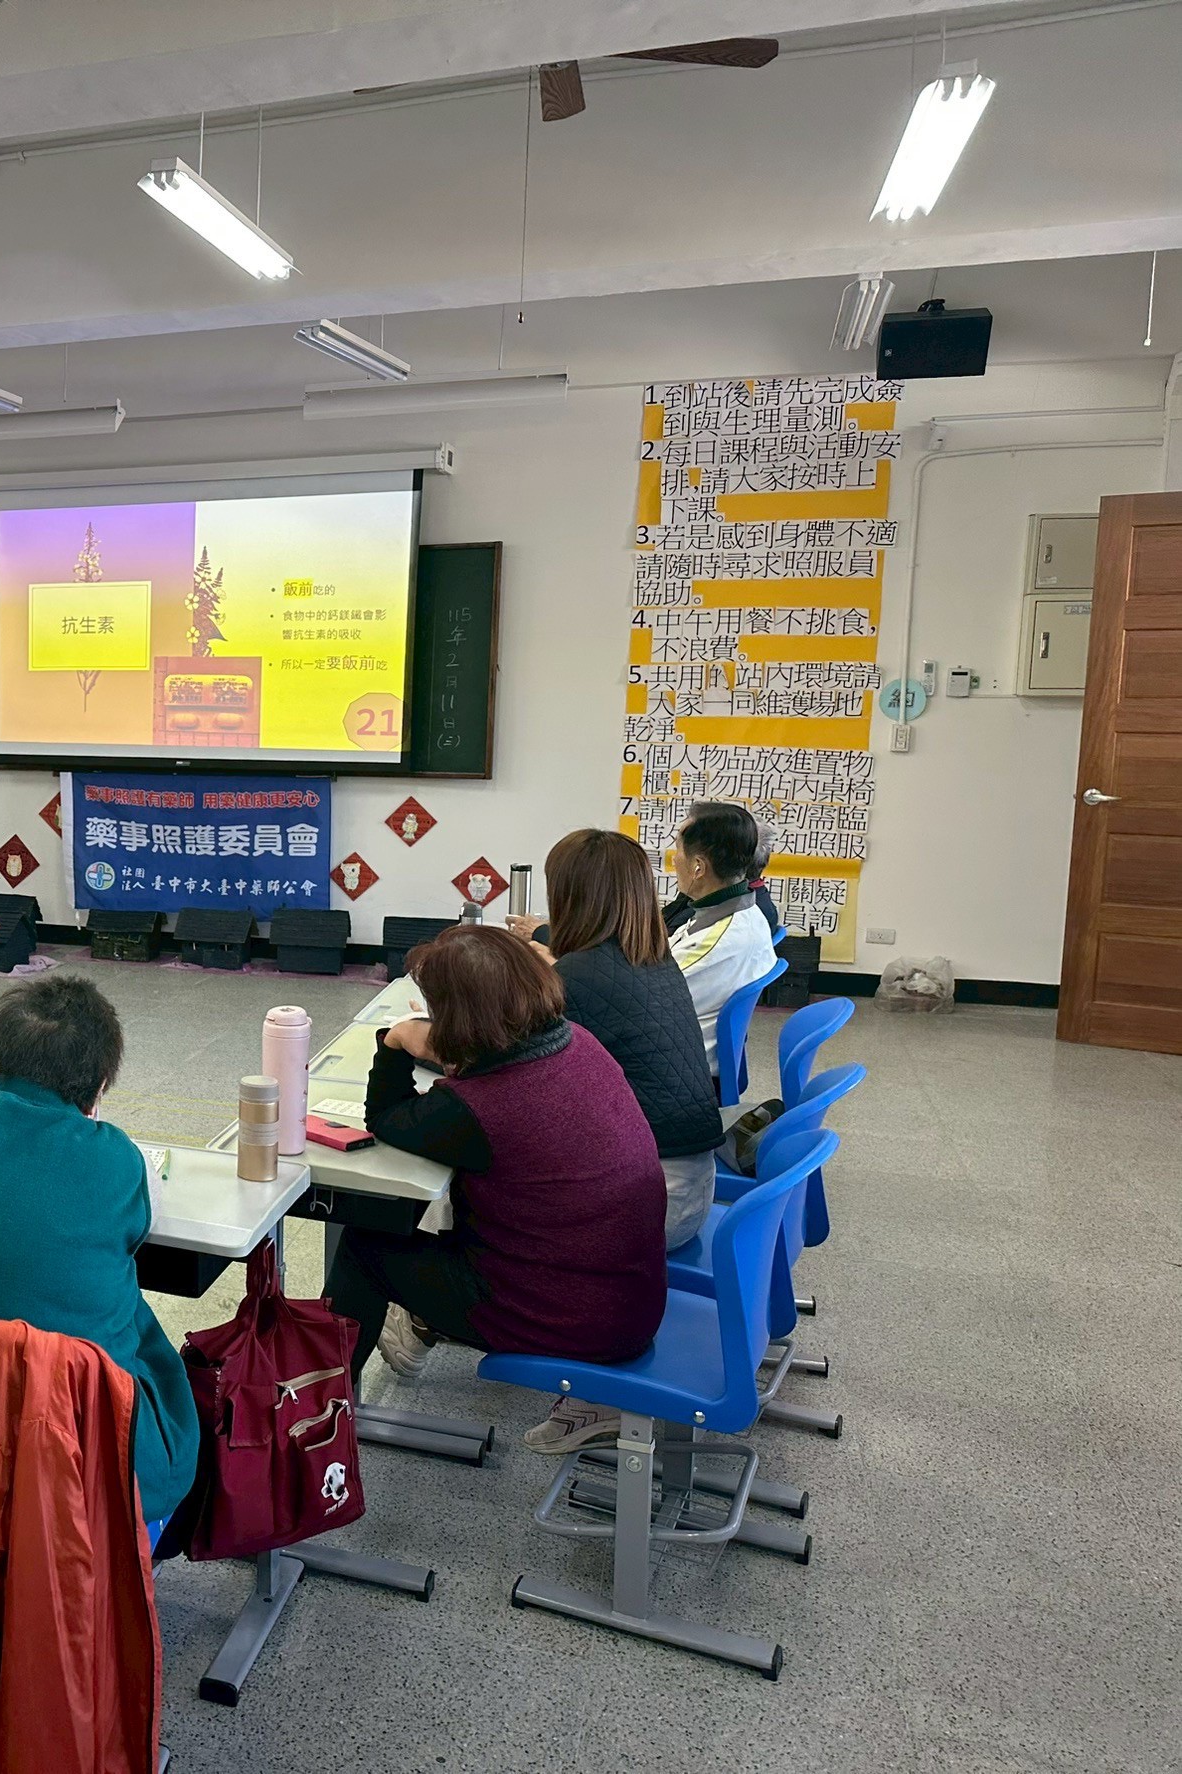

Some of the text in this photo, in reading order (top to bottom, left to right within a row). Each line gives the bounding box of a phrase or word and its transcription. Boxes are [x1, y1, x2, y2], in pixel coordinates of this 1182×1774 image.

[661, 497, 723, 523] 下課。
[636, 552, 874, 579] 請隨時尋求照服員
[283, 582, 336, 597] 飯前吃的
[635, 580, 702, 605] 協助。
[61, 615, 115, 635] 抗生素
[282, 628, 362, 641] 響抗生素的吸收
[280, 654, 388, 671] 所以一定要飯前吃
[356, 708, 399, 737] 21
[84, 785, 320, 809] 藥事照護有藥師 用藥健康更安心
[85, 816, 319, 857] 藥事照護委員會
